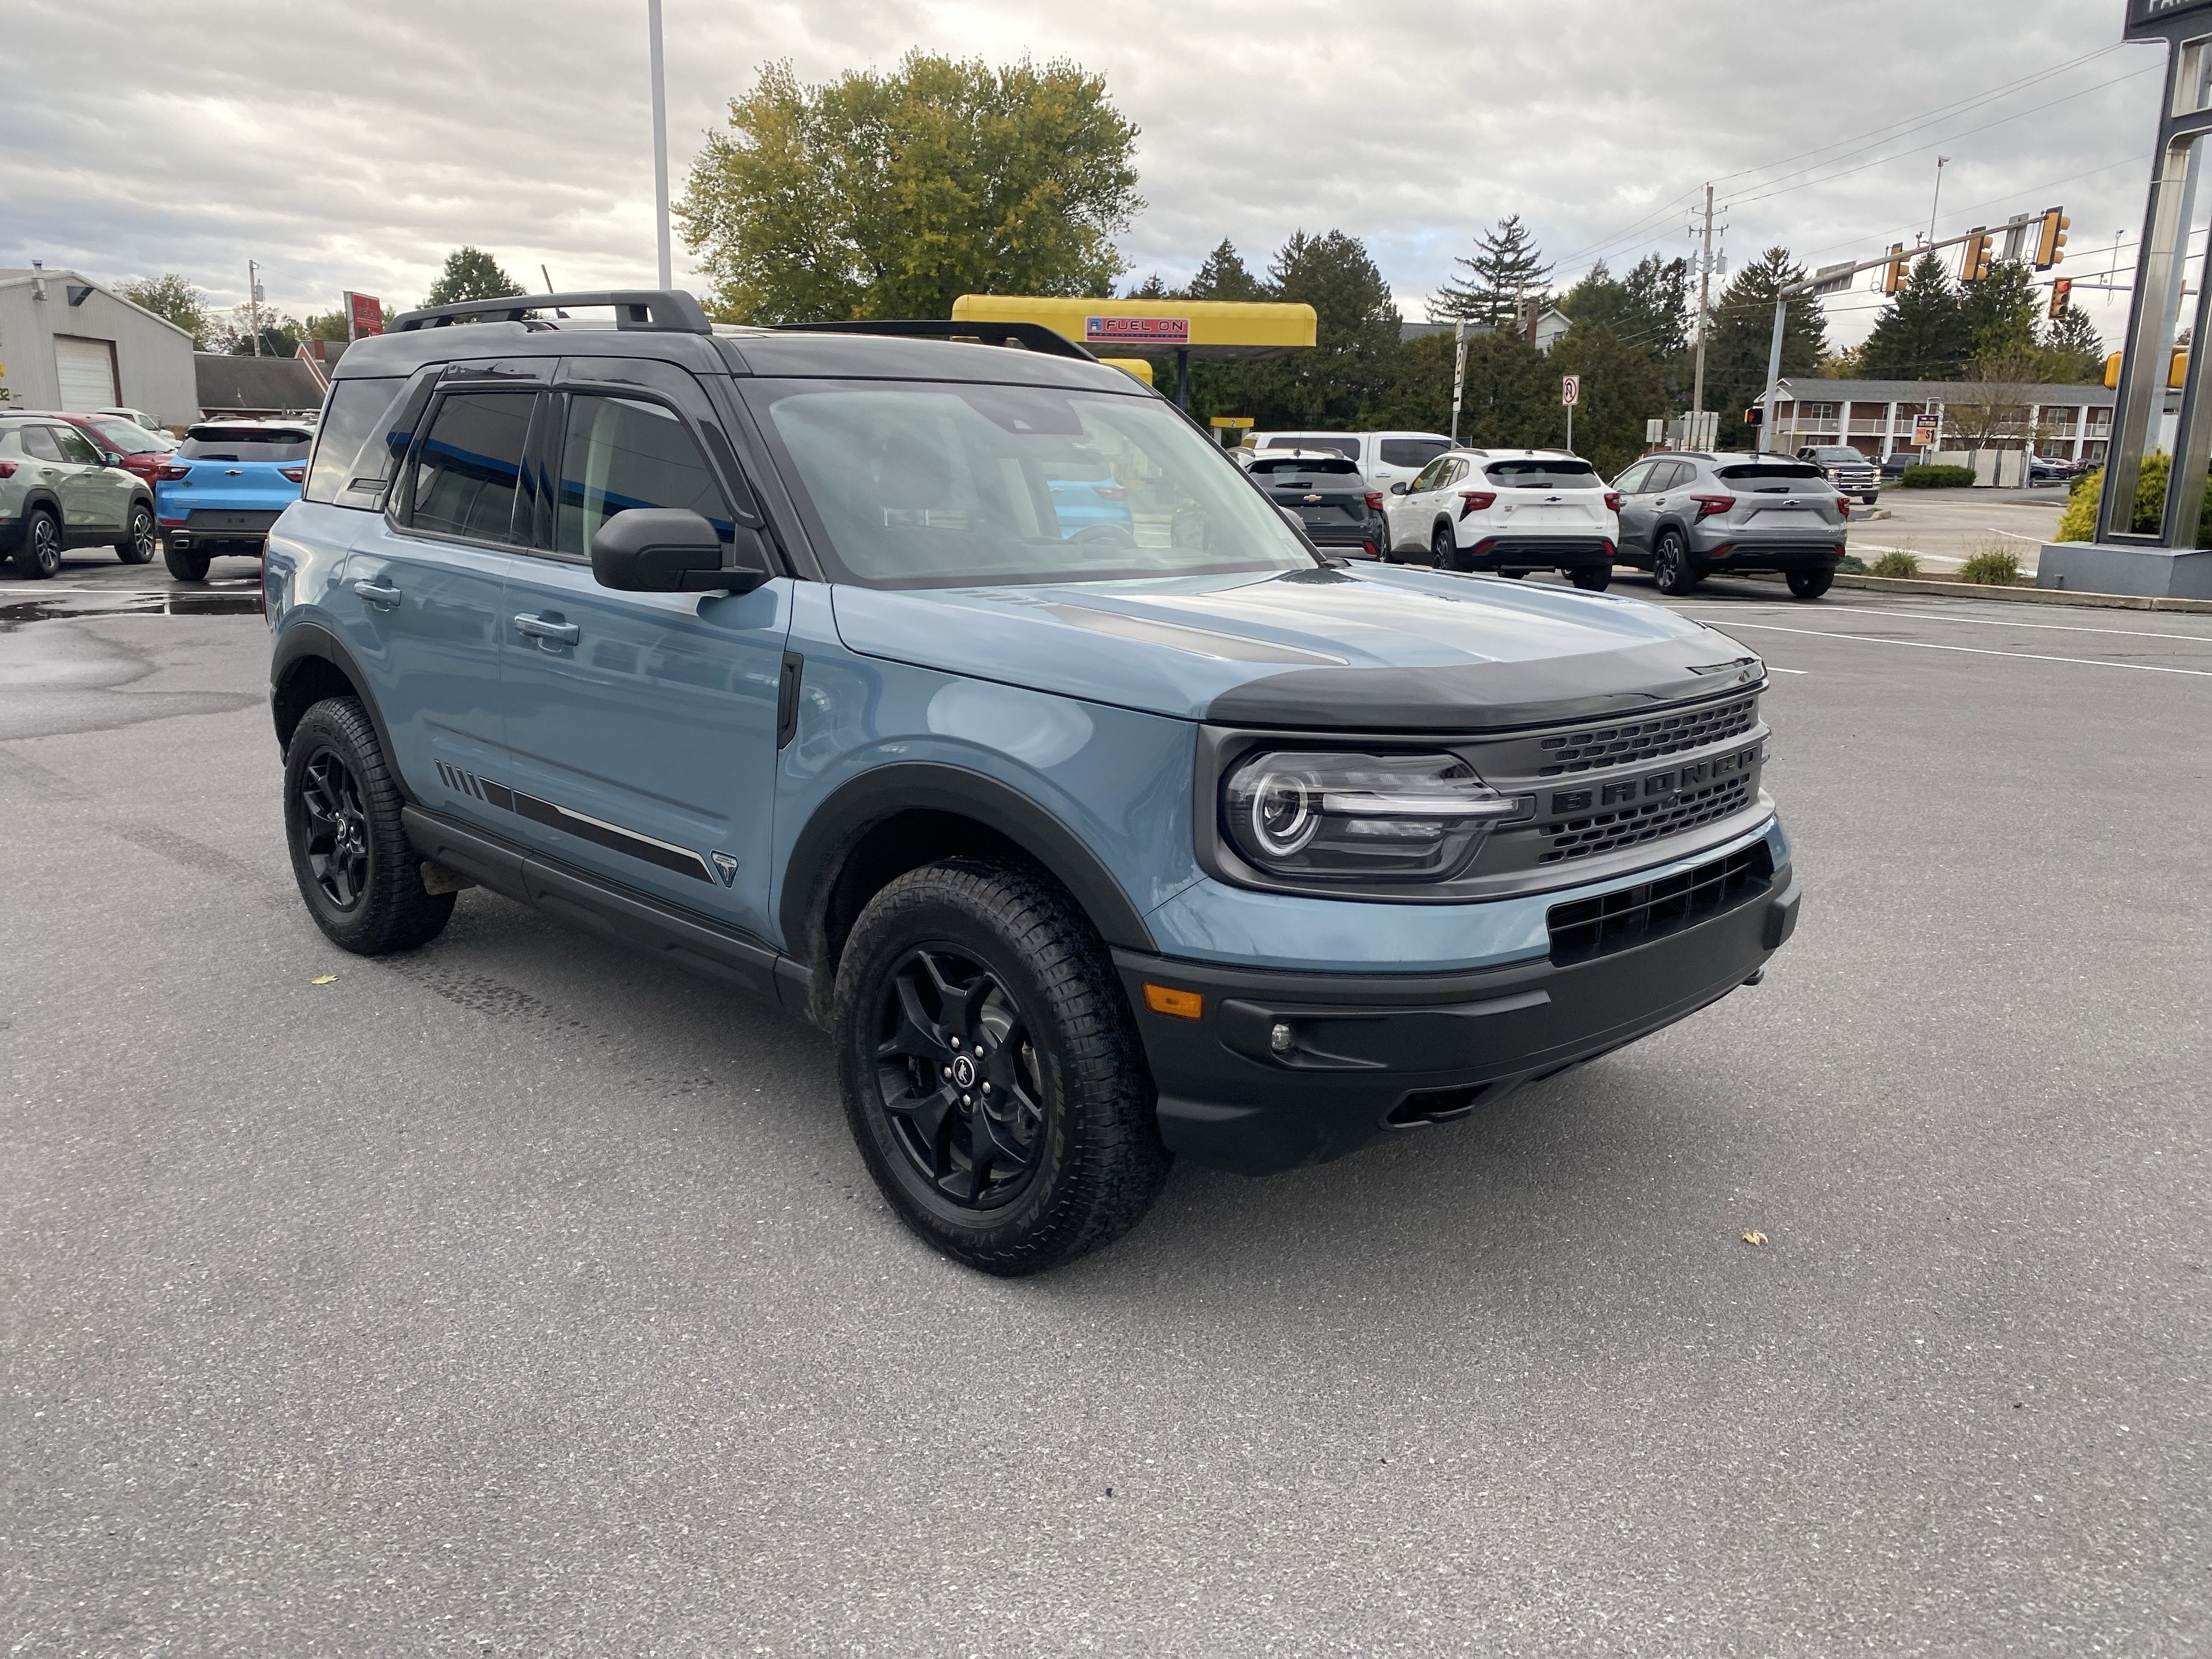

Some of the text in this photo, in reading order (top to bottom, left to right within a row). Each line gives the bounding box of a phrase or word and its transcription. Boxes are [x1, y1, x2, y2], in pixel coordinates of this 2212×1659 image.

[1106, 320, 1183, 331] FUEL ON
[1551, 746, 1758, 815] BRONCO
